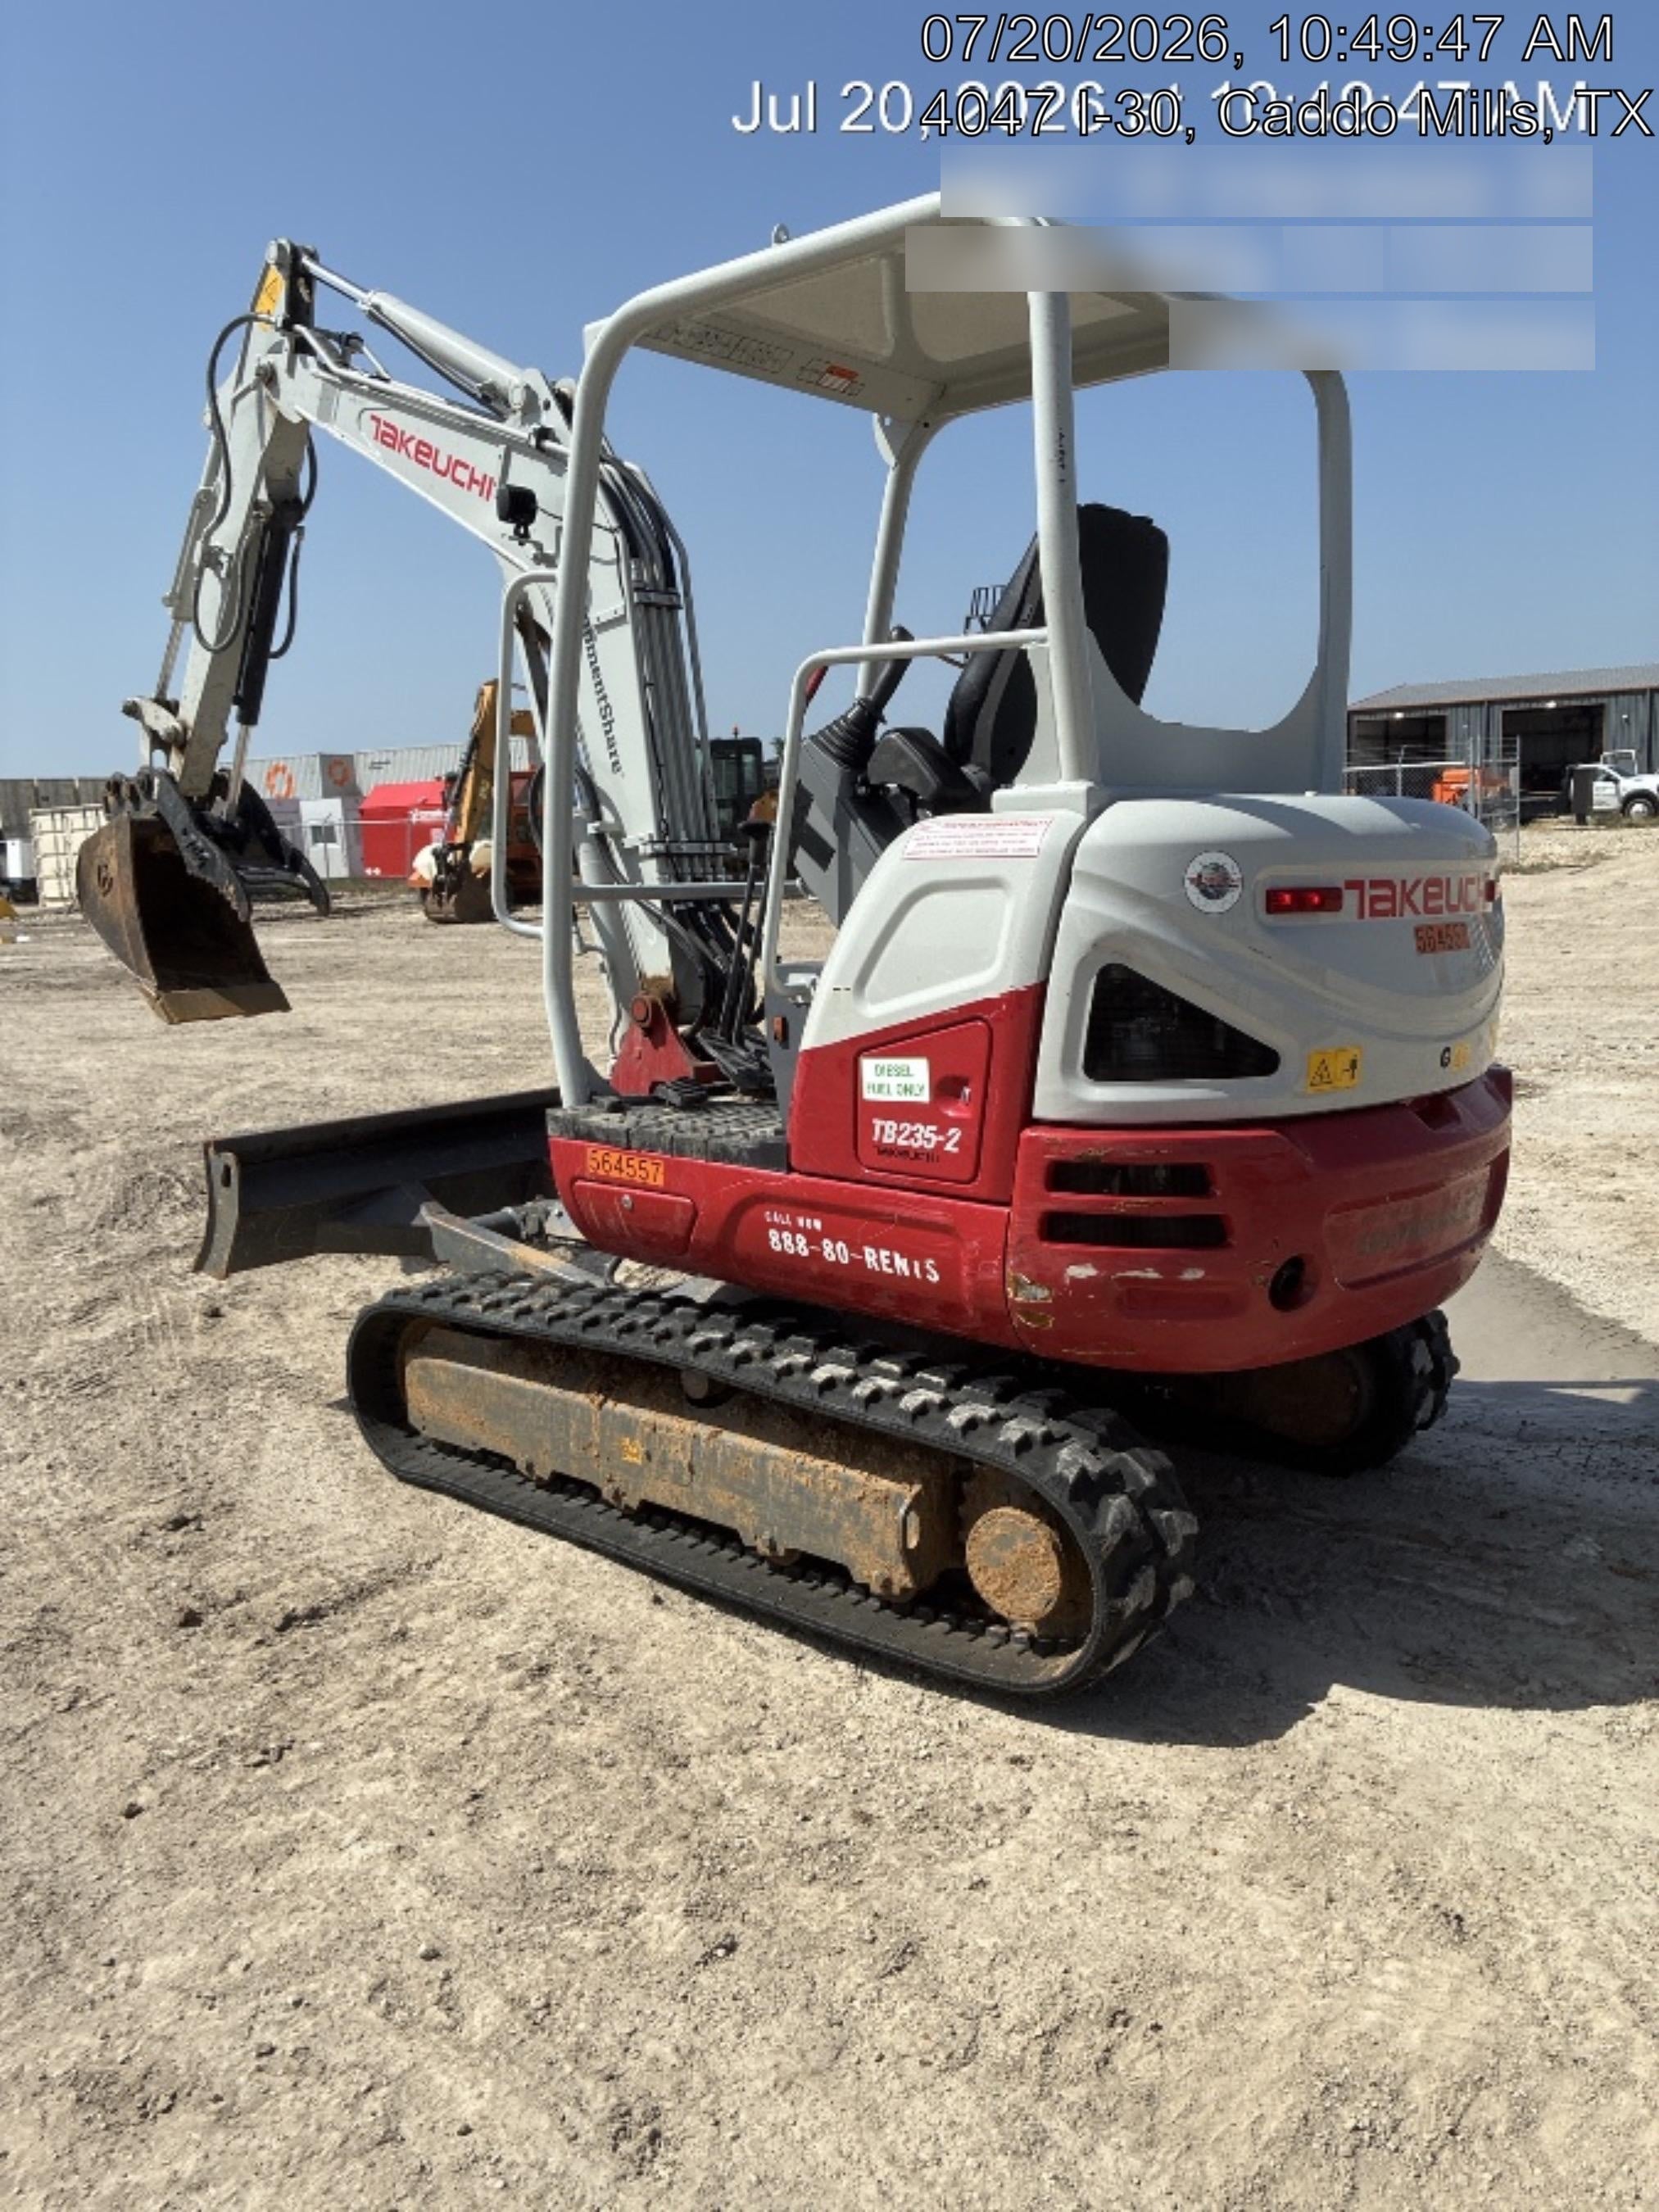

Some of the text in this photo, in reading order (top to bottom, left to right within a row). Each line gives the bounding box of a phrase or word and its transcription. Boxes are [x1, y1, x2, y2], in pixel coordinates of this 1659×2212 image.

[873, 1063, 915, 1078] DIESEL
[866, 1082, 926, 1097] FUEL ONLY
[871, 1117, 963, 1154] TB235-2
[589, 1149, 662, 1183] 564557
